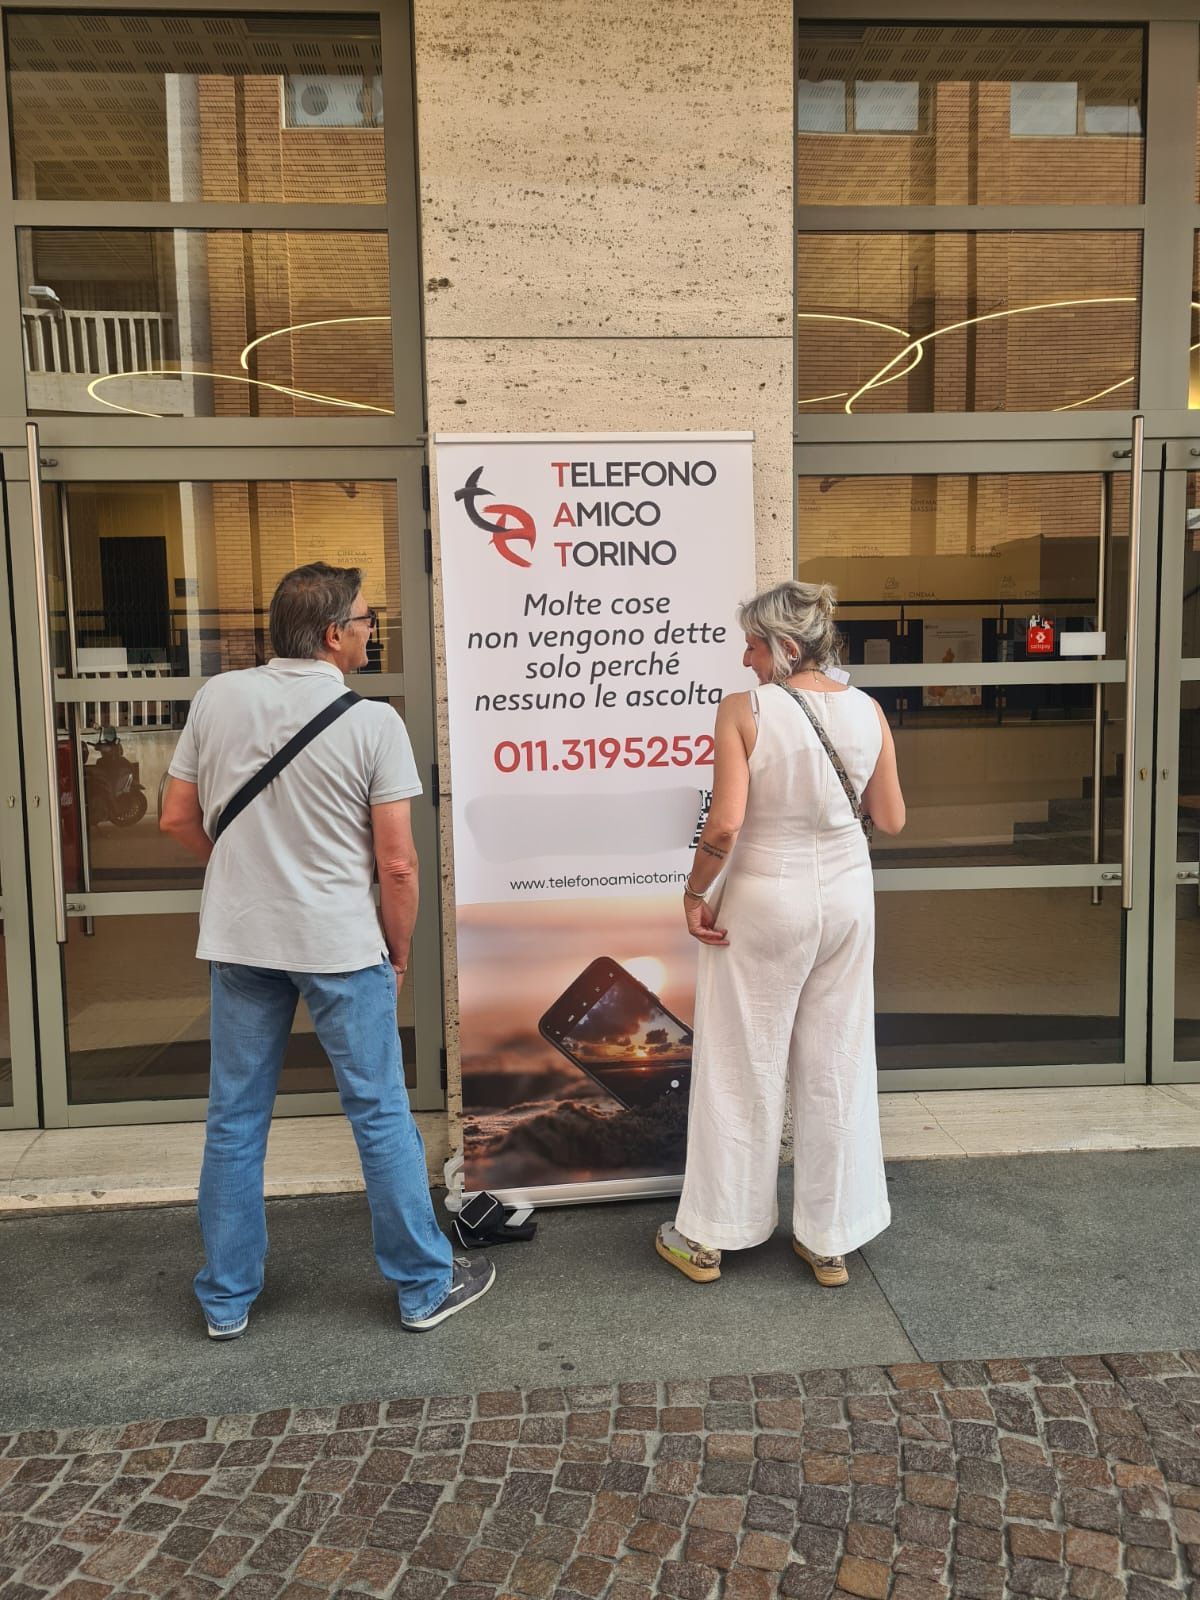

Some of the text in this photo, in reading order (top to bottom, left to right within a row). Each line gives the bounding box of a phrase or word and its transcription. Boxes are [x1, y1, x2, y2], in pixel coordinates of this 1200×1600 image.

[551, 460, 717, 488] TELEFONO
[553, 500, 661, 528] AMICO
[554, 539, 677, 568] TORINO
[523, 590, 671, 617] Molte cose
[467, 620, 727, 655] non vengono dette
[525, 651, 680, 685] solo perché
[475, 681, 723, 712] nessuno le ascolta
[493, 734, 715, 773] 011.3195252
[509, 871, 690, 891] www.telefonoamicotorin
